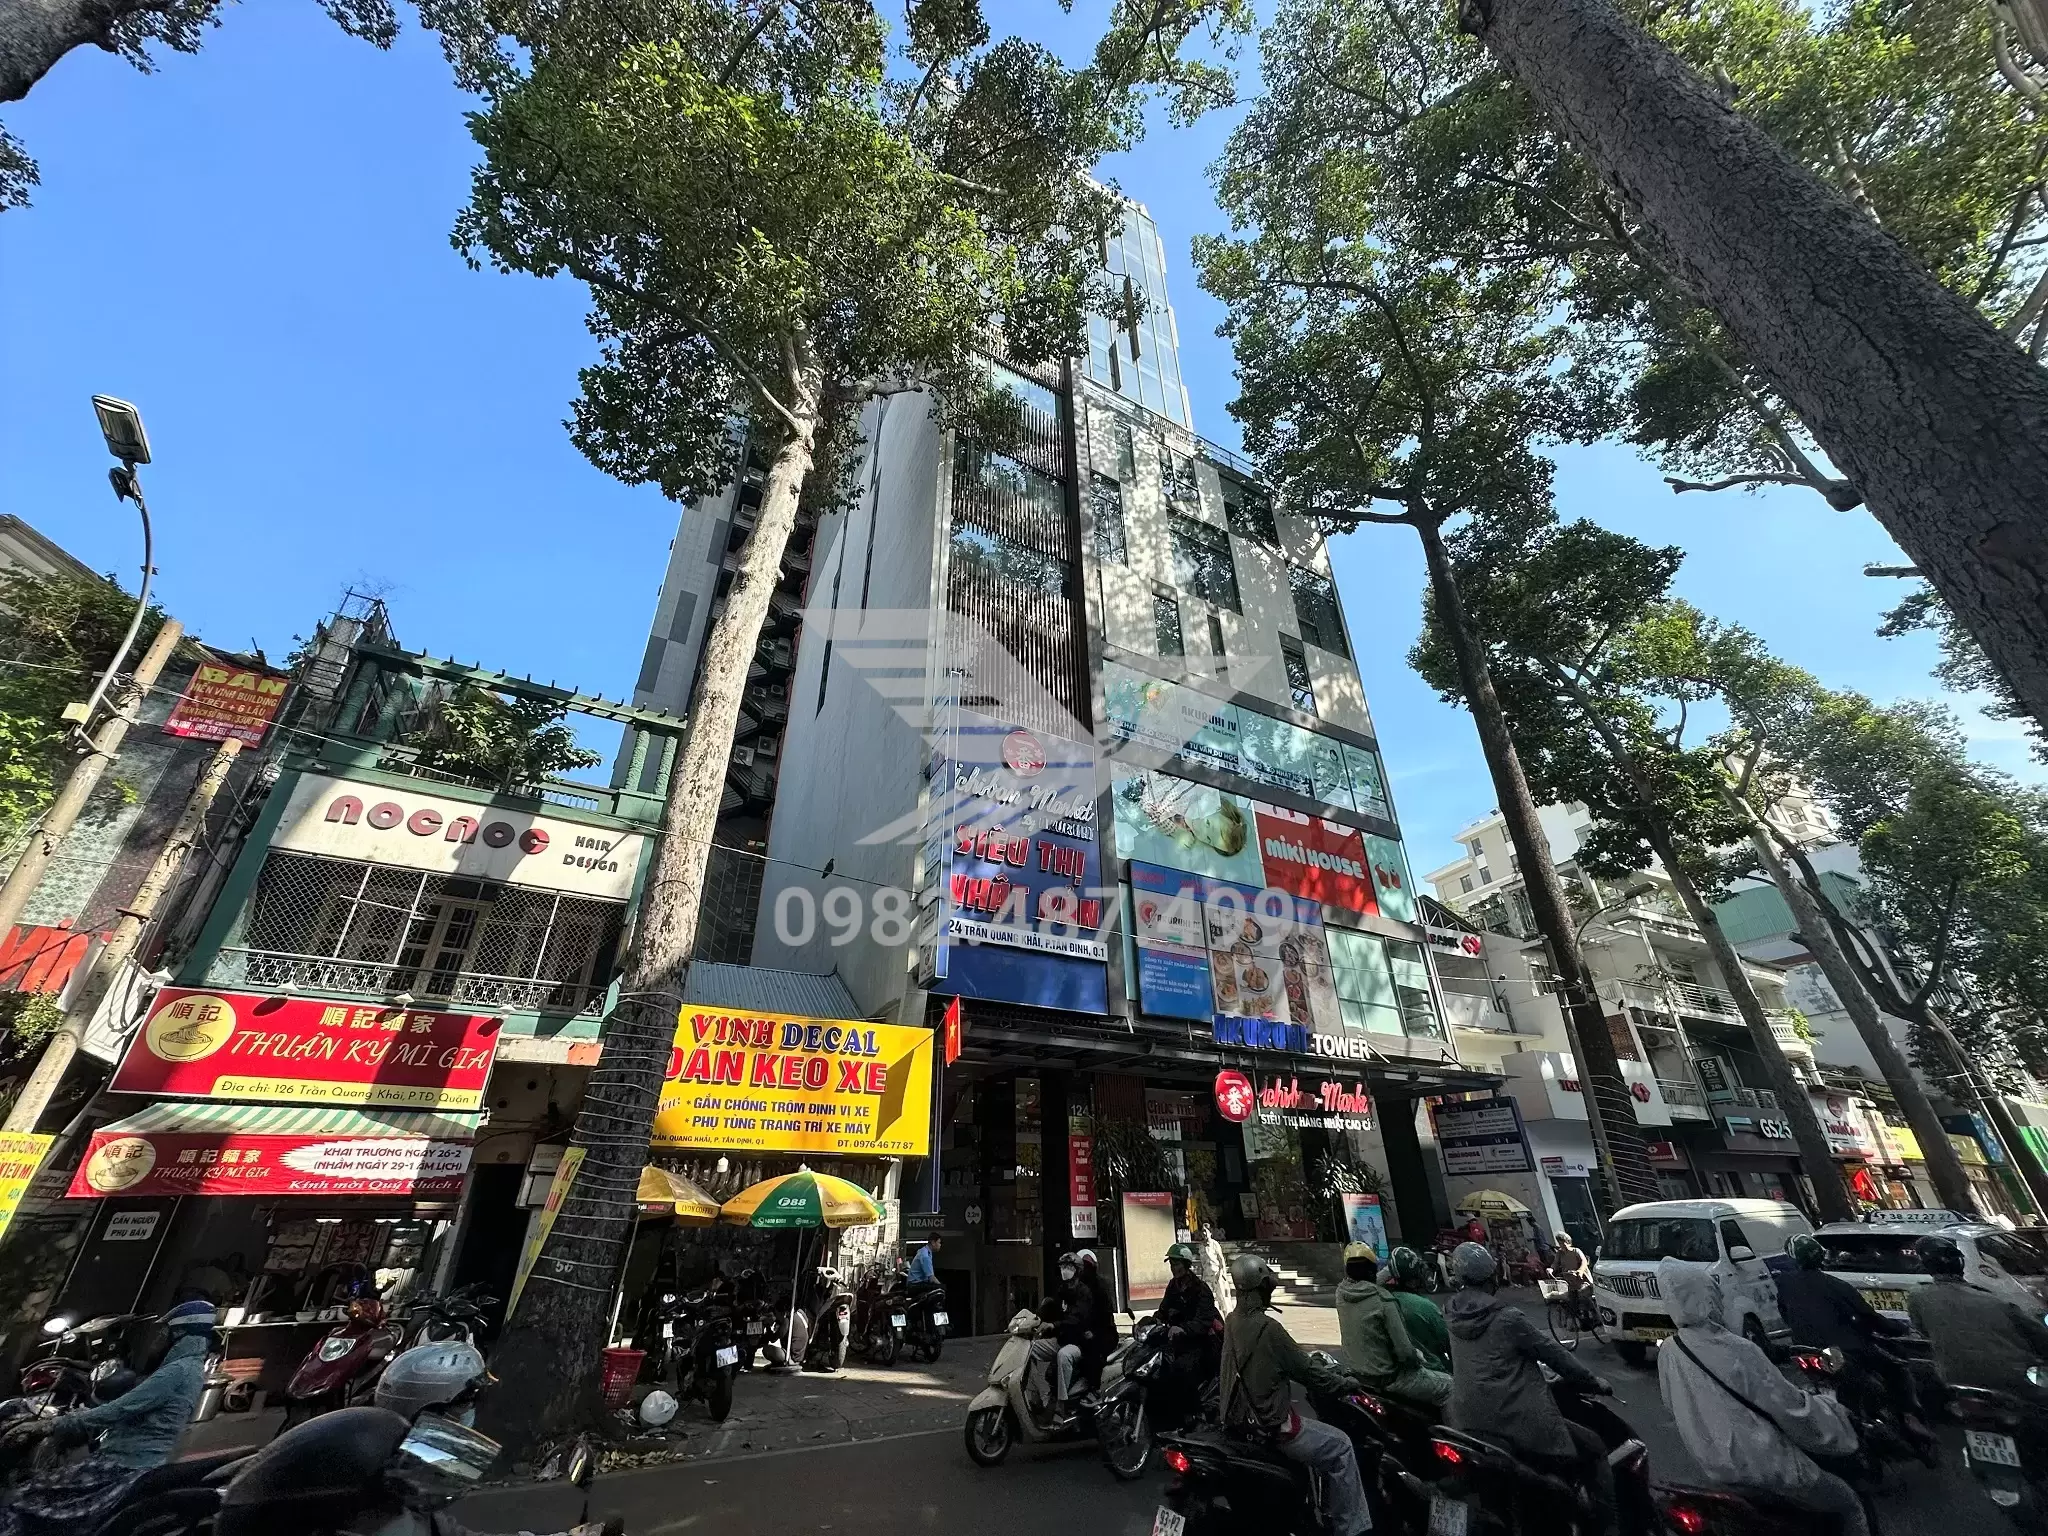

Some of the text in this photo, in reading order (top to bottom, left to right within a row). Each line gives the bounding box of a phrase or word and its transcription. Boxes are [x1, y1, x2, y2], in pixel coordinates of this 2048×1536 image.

[198, 666, 287, 695] BÁN
[237, 691, 277, 707] BUILDING
[1029, 785, 1096, 822] Market
[575, 836, 610, 852] HAIR
[563, 854, 618, 872] DESIGN
[954, 824, 1087, 886] SIÊU THỊ
[1307, 850, 1365, 880] HOUSE
[964, 922, 988, 940] TRẦN
[990, 929, 1019, 945] QUANG
[1093, 945, 1105, 958] Q.1
[168, 1002, 221, 1022] 順記
[691, 1013, 880, 1055] VINH DECAL
[231, 1029, 488, 1070] THUẬN KÝ MÌ GIA
[1312, 1033, 1371, 1060] TOWER
[751, 1053, 830, 1089] KEO
[837, 1059, 888, 1094] XE
[1700, 1061, 1715, 1069] GS
[1704, 1070, 1718, 1078] 25
[221, 1079, 245, 1094] Địa
[274, 1085, 295, 1095] 126
[300, 1083, 327, 1096] Trần
[331, 1087, 373, 1101] Quang
[438, 1094, 470, 1107] Quận
[1223, 1079, 1246, 1115] 一番
[694, 1093, 870, 1119] GẮN CHỐNG TRỘM ĐỊNH VỊ XE
[1071, 1104, 1089, 1117] 124
[692, 1114, 872, 1135] PHỤ TÙNG TRANG TRÍ XE MÁY
[1261, 1112, 1281, 1127] SIÊU
[1283, 1115, 1299, 1131] THỊ
[1300, 1113, 1323, 1129] HÀNG
[1345, 1118, 1362, 1131] CAO
[1760, 1119, 1793, 1139] GS25
[669, 1134, 693, 1143] QUANG
[722, 1135, 735, 1144] TÂN
[853, 1140, 876, 1149] 0976
[877, 1140, 888, 1149] 46
[889, 1141, 901, 1150] 77
[902, 1142, 914, 1150] 87
[324, 1146, 462, 1159] KHAI TRƯƠNG NGÀY 26-2
[154, 1166, 201, 1181] THUẬN
[225, 1166, 245, 1179] MÌ
[245, 1167, 270, 1179] GIA
[351, 1157, 388, 1171] NGÀY
[390, 1161, 414, 1171] 29-1
[416, 1158, 434, 1171] ÂM
[289, 1177, 329, 1191] Kính
[333, 1178, 363, 1191] mời
[368, 1178, 402, 1194] Quý
[406, 1178, 454, 1191] Khách
[908, 1218, 945, 1228] NTRANCE
